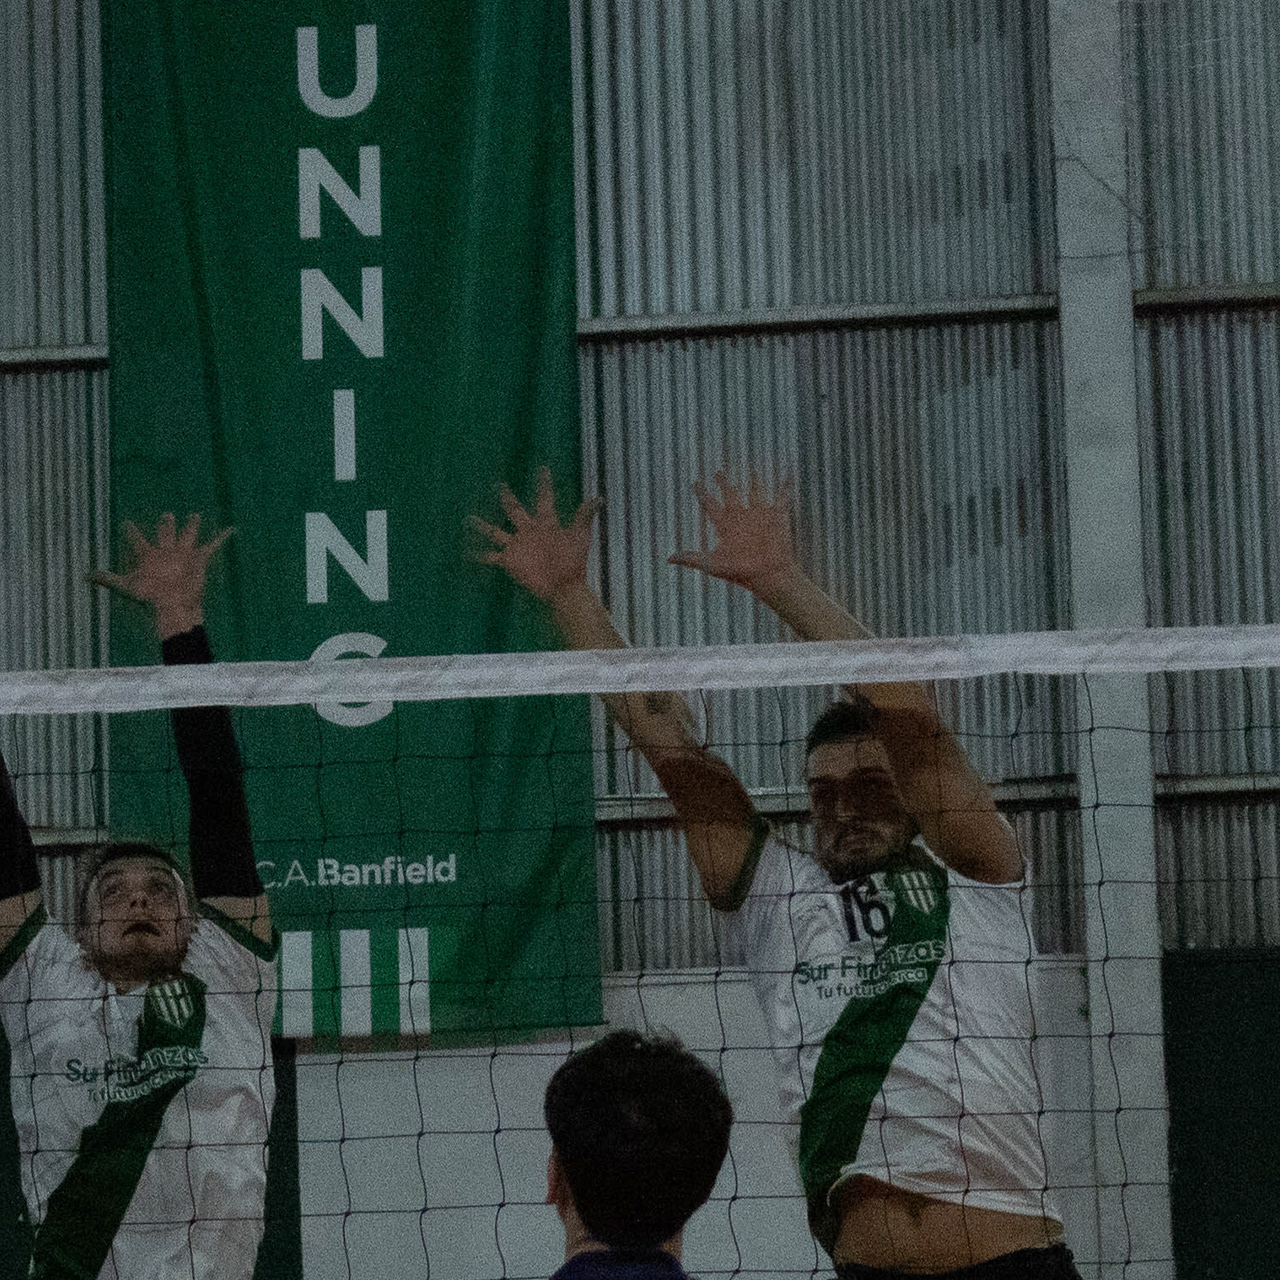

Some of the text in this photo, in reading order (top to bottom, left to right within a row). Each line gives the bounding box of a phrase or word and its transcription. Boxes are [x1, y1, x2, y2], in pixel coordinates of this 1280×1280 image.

[317, 853, 458, 886] Banfield
[840, 873, 892, 942] 16
[797, 960, 834, 985] Sur
